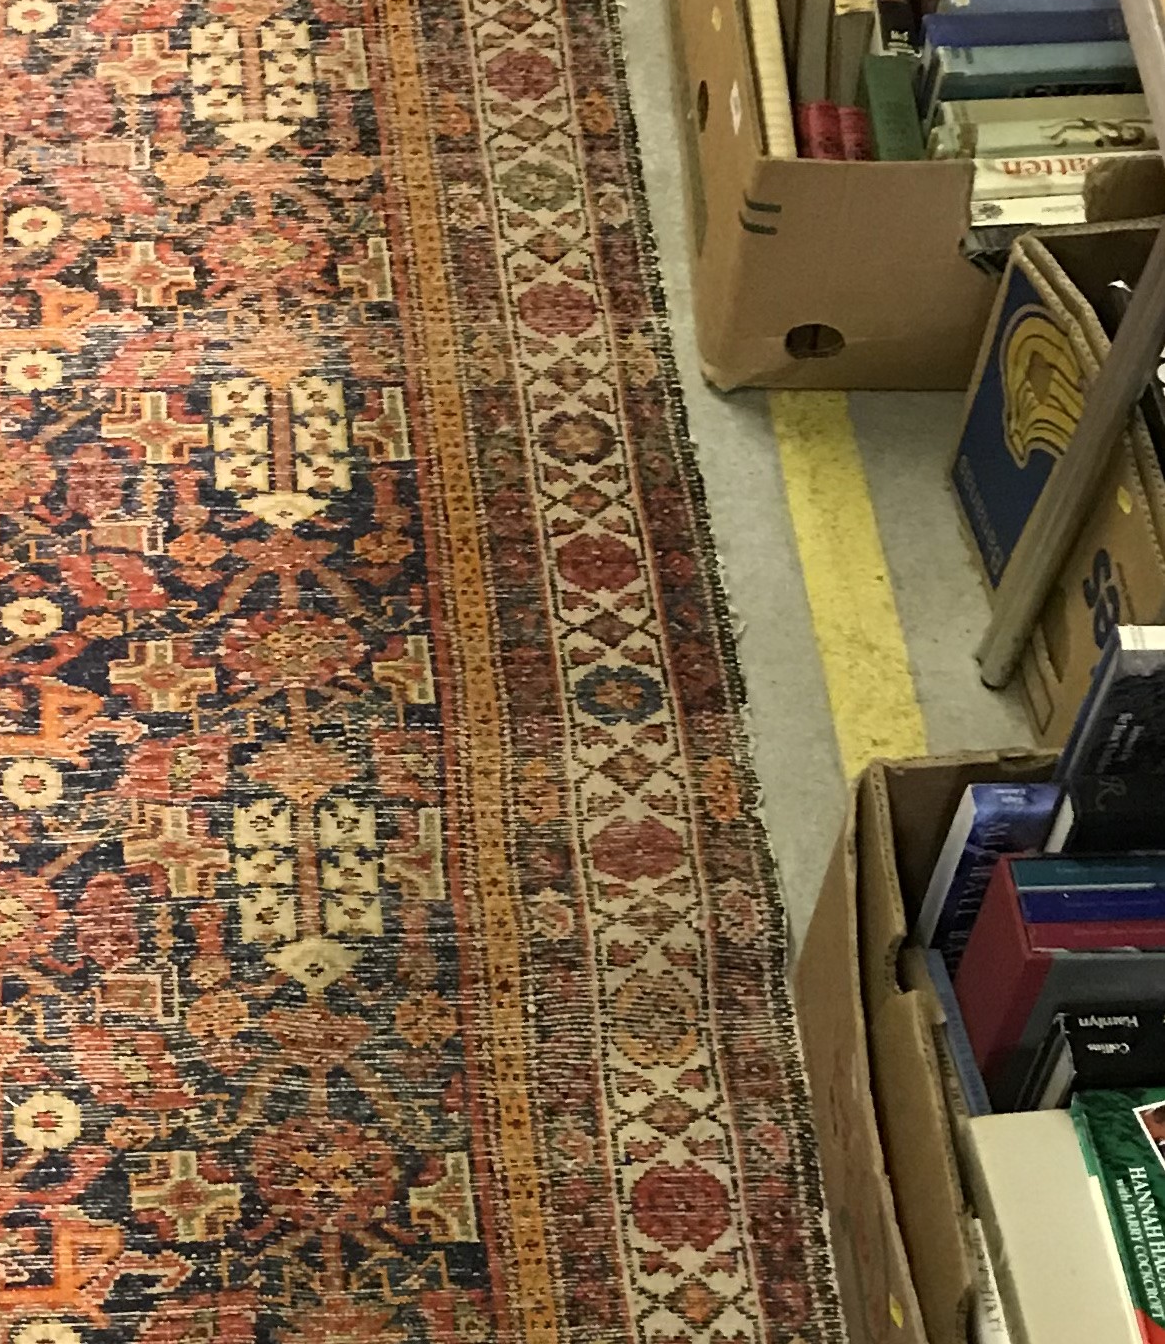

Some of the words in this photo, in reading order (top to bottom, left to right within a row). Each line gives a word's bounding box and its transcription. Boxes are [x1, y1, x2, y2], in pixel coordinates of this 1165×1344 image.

[1078, 1015, 1139, 1029] Hamlyn
[1115, 1177, 1133, 1203] with
[1128, 1166, 1164, 1239] HANNAH
[1121, 1203, 1144, 1243] BARRY
[1133, 1244, 1165, 1320] COCKCROFT
